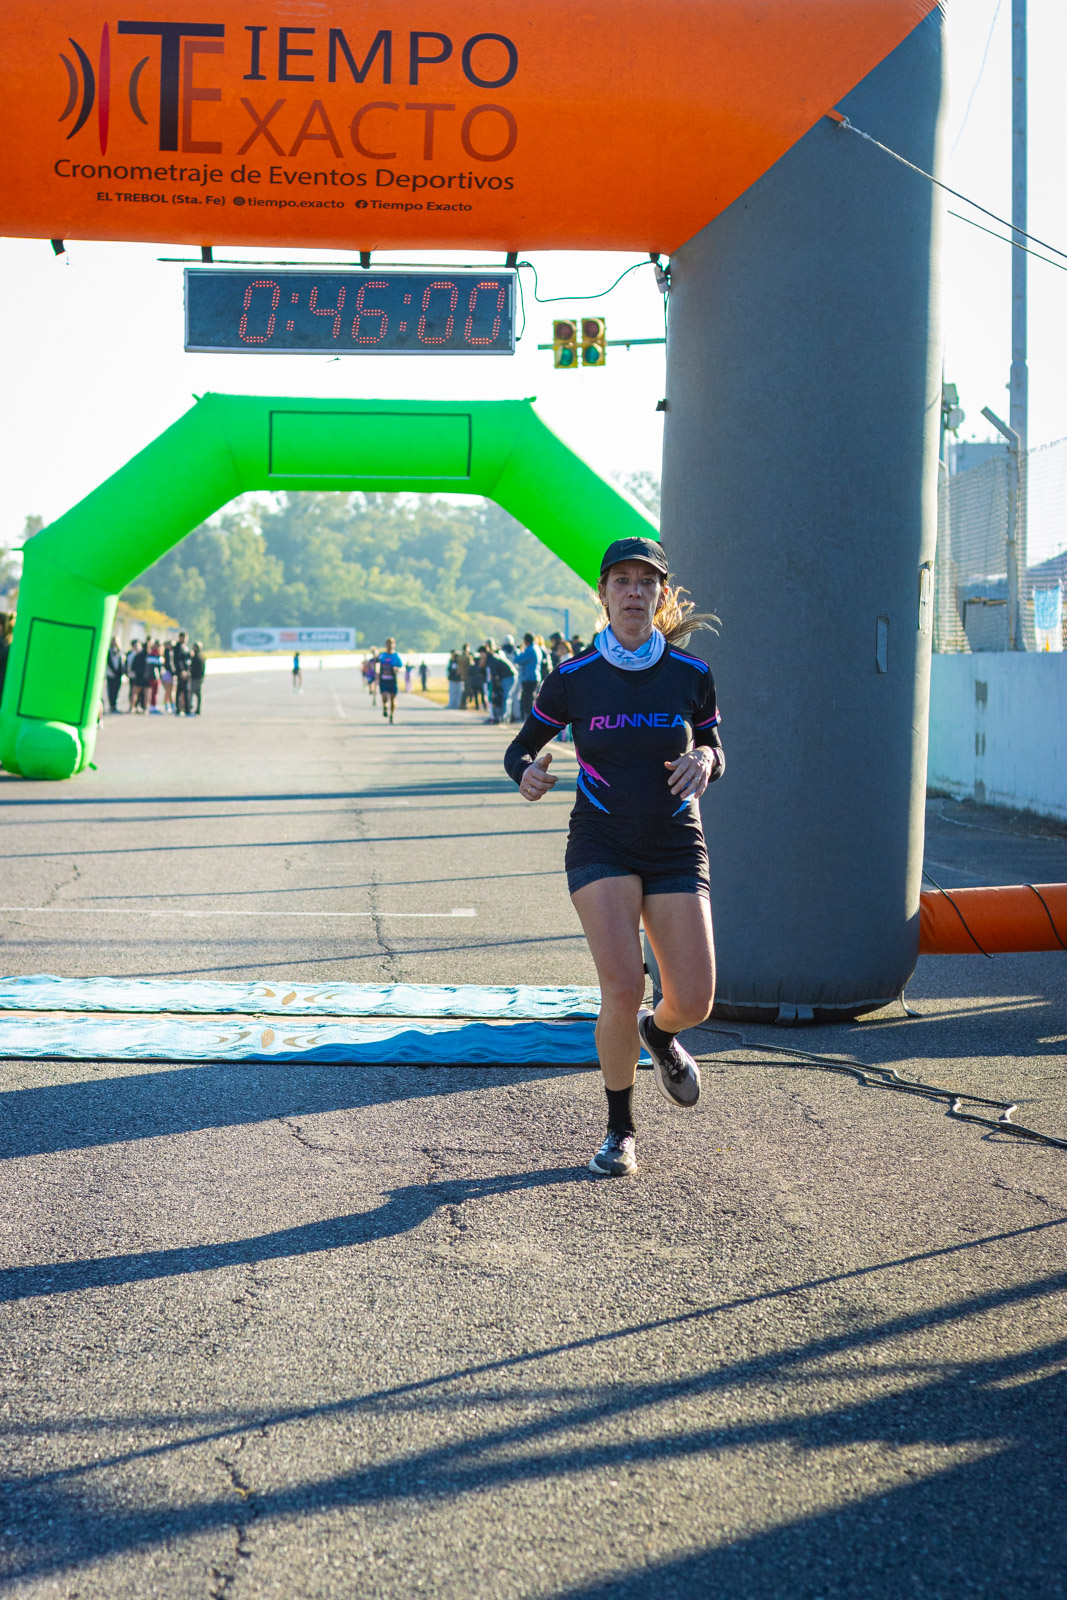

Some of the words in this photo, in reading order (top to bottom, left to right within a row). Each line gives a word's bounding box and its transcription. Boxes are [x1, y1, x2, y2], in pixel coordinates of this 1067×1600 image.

[54, 158, 223, 187] Cronometraje
[230, 164, 261, 183] de
[269, 166, 367, 187] Eventos
[375, 168, 514, 192] Deportivos
[97, 191, 112, 202] EL
[115, 192, 169, 204] TREBOL
[172, 194, 202, 206] (Sta.
[205, 195, 226, 207] Fe)
[248, 197, 345, 210] tiempo.exacto
[370, 199, 423, 212] Tiempo
[426, 201, 473, 212] Exacto
[238, 280, 506, 345] 0:46:00
[589, 713, 687, 731] RUNNEA
